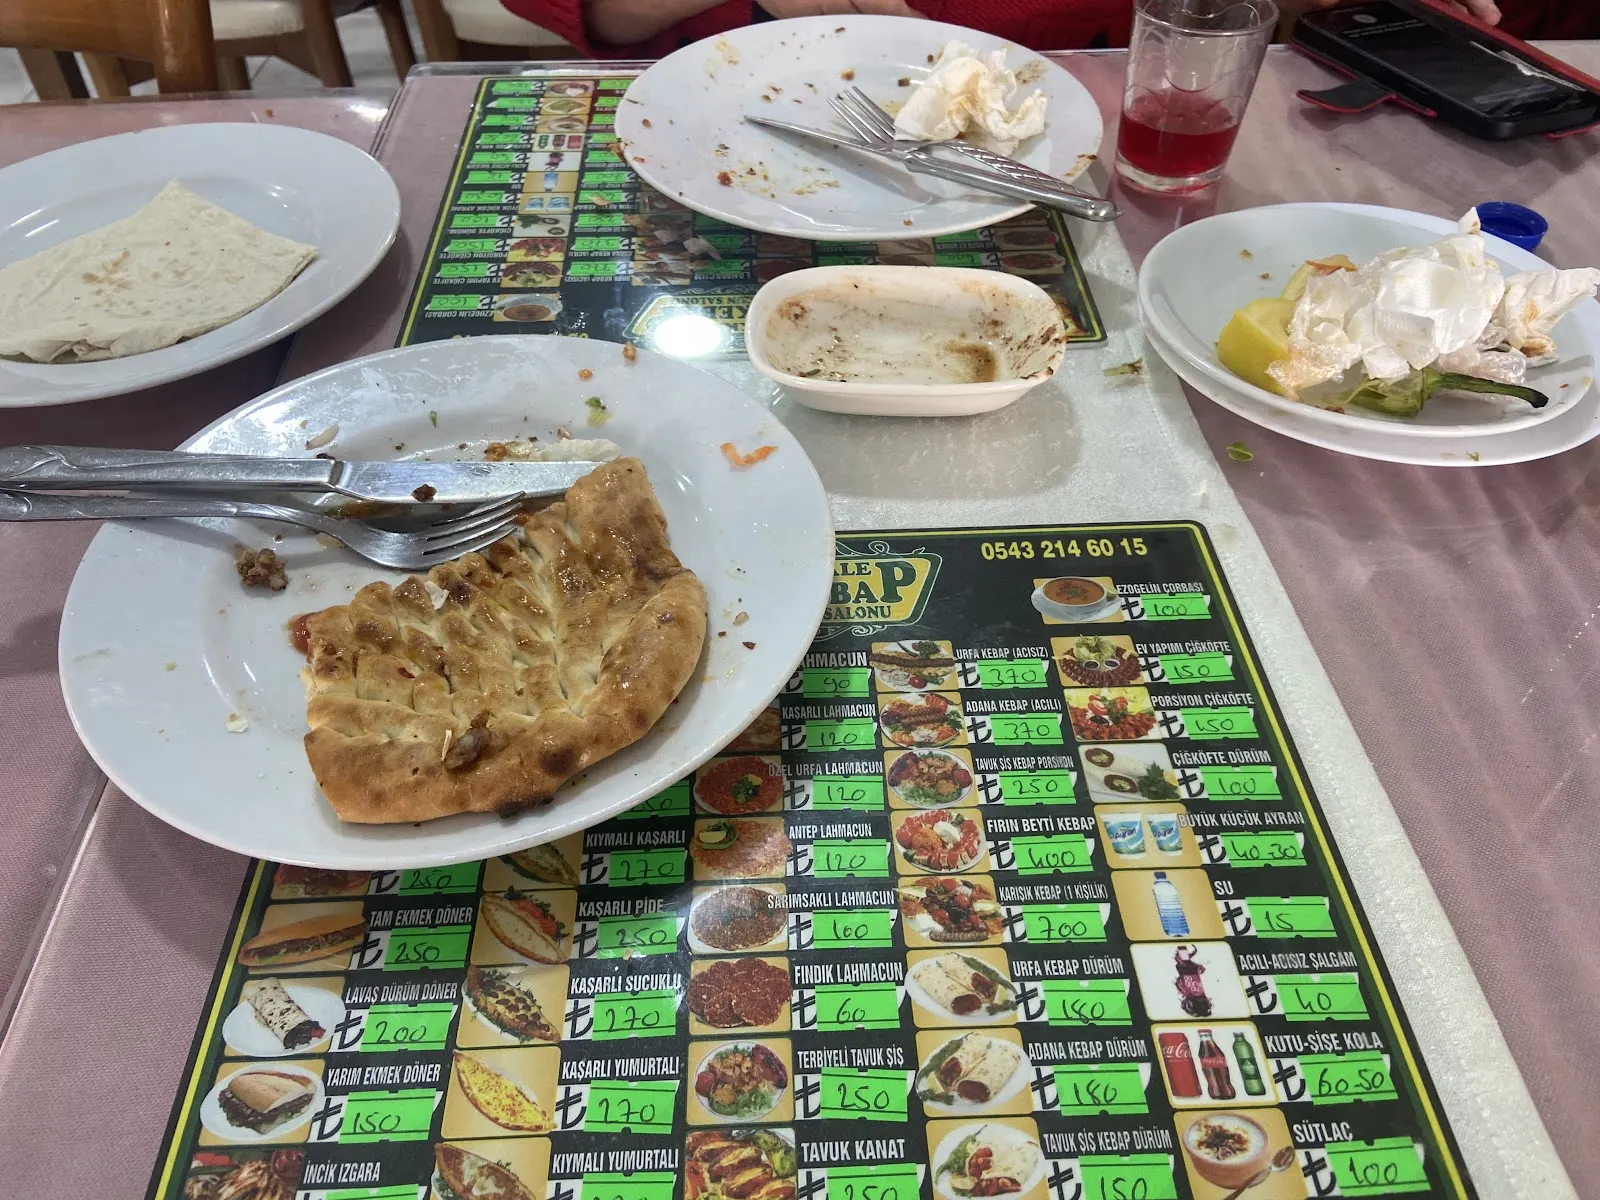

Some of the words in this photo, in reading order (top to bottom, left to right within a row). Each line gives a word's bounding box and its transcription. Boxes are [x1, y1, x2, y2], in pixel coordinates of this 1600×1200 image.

[981, 541, 1036, 561] 0543
[1041, 539, 1080, 559] 214
[1086, 539, 1114, 558] 60
[1120, 537, 1148, 556] 15
[830, 561, 918, 605] BAP
[1116, 580, 1161, 594] EZOGELİN
[1163, 580, 1204, 595] ÇORBASI
[823, 605, 892, 620] SALONU
[1154, 604, 1188, 617] 100
[956, 648, 980, 660] URFA
[981, 648, 1010, 660] KEBAP
[1012, 646, 1050, 659] (ACISIZ)
[1136, 644, 1148, 654] EV
[1149, 641, 1183, 654] YAPIMI
[1185, 640, 1231, 654] ÇİĞKÖFTE
[800, 652, 868, 668] AHMACUN
[988, 668, 1037, 688] 370
[1174, 664, 1210, 678] 150
[966, 701, 998, 712] ADANA
[999, 700, 1028, 712] KEBAP
[1032, 698, 1062, 711] (ACILI)
[1151, 692, 1201, 707] PORSİYON
[1204, 691, 1254, 706] ÇİĞKÖFTE
[782, 704, 820, 721] KAŞARLI
[823, 703, 876, 718] LAHMACUN
[820, 732, 858, 746] 120
[1004, 722, 1050, 740] 370
[975, 758, 999, 770] TAVUK
[1012, 756, 1036, 768] KEBAP
[1172, 749, 1227, 766] ÇİĞKÖFTE
[1229, 748, 1272, 763] DÜRÜM
[795, 762, 823, 776] URFA
[824, 760, 884, 776] LAHMACUN
[826, 786, 866, 802] 120
[1012, 778, 1058, 794] 250
[1218, 777, 1256, 794] 100
[986, 819, 1020, 832] FIRIN
[1022, 815, 1056, 832] BEYTİ
[1057, 816, 1096, 830] KEBAP
[1178, 812, 1219, 828] BÜYÜK
[1220, 810, 1262, 828] KÜÇÜK
[1264, 811, 1305, 825] AYRAN
[586, 831, 634, 848] KIYMALI
[636, 830, 686, 846] KAŞARLI
[789, 824, 818, 840] ANTEP
[820, 823, 873, 838] LAHMACUN
[826, 852, 867, 870] 120
[1028, 848, 1076, 868] 400
[620, 860, 674, 882] 270
[999, 886, 1032, 902] KARIŞIK
[1034, 886, 1062, 900] KEBAP
[1214, 880, 1234, 896] SU
[579, 899, 632, 918] KAŞARLI
[635, 896, 664, 914] PİDE
[768, 892, 832, 909] SARIMSAKLI
[835, 890, 896, 907] LAHMACUN
[369, 910, 392, 928] TAM
[394, 908, 433, 926] EKMEK
[434, 904, 474, 924] DÖNER
[1264, 910, 1294, 932] 15
[616, 928, 667, 946] 250
[1038, 916, 1088, 942] 700
[395, 942, 440, 964] 250
[1239, 954, 1310, 970] ACILI-ACISIZ
[1312, 952, 1358, 970] ŞALGAM
[794, 964, 834, 984] FINDIK
[836, 962, 904, 984] LAHMACUN
[1012, 960, 1042, 977] URFA
[1044, 959, 1080, 976] KEBAP
[1082, 955, 1125, 974] DÜRÜM
[344, 986, 379, 1006] LAVAŞ
[381, 982, 420, 1002] DÜRÜM
[422, 980, 458, 1000] DÖNER
[570, 974, 622, 996] KAŞARLI
[625, 972, 682, 992] SUCUKLU
[836, 998, 866, 1024] 60
[1294, 988, 1332, 1013] 40
[606, 1006, 660, 1032] 270
[376, 1020, 427, 1044] 200
[1264, 1030, 1342, 1053] KUTU-ŞİŞE
[1344, 1032, 1384, 1049] KOLA
[798, 1046, 849, 1069] TERBİYELİ
[850, 1048, 885, 1068] TAVUK
[886, 1044, 904, 1068] ŞİŞ
[1028, 1042, 1067, 1060] ADANA
[1068, 1040, 1104, 1059] KEBAP
[1106, 1036, 1148, 1058] DÜRÜM
[326, 1067, 362, 1087] YARIM
[363, 1064, 400, 1085] EKMEK
[402, 1060, 442, 1082] DÖNER
[562, 1060, 612, 1080] KAŞARLI
[614, 1056, 680, 1077] YUMURTALI
[838, 1082, 890, 1109] 250
[598, 1098, 656, 1124] 270
[354, 1112, 400, 1135] 150
[1292, 1120, 1354, 1144] SÜTLAÇ
[800, 1140, 851, 1163] TAVUK
[855, 1138, 906, 1161] KANAT
[1042, 1132, 1076, 1154] TAVUK
[1078, 1128, 1096, 1154] ŞİŞ
[1097, 1131, 1132, 1151] KEBAP
[1132, 1126, 1173, 1149] DÜRÜM
[552, 1152, 604, 1174] KIYMALI
[608, 1148, 679, 1171] YUMURTALI
[1350, 1156, 1398, 1185] 100
[303, 1160, 336, 1185] İNCİK
[338, 1161, 381, 1182] IZGARA
